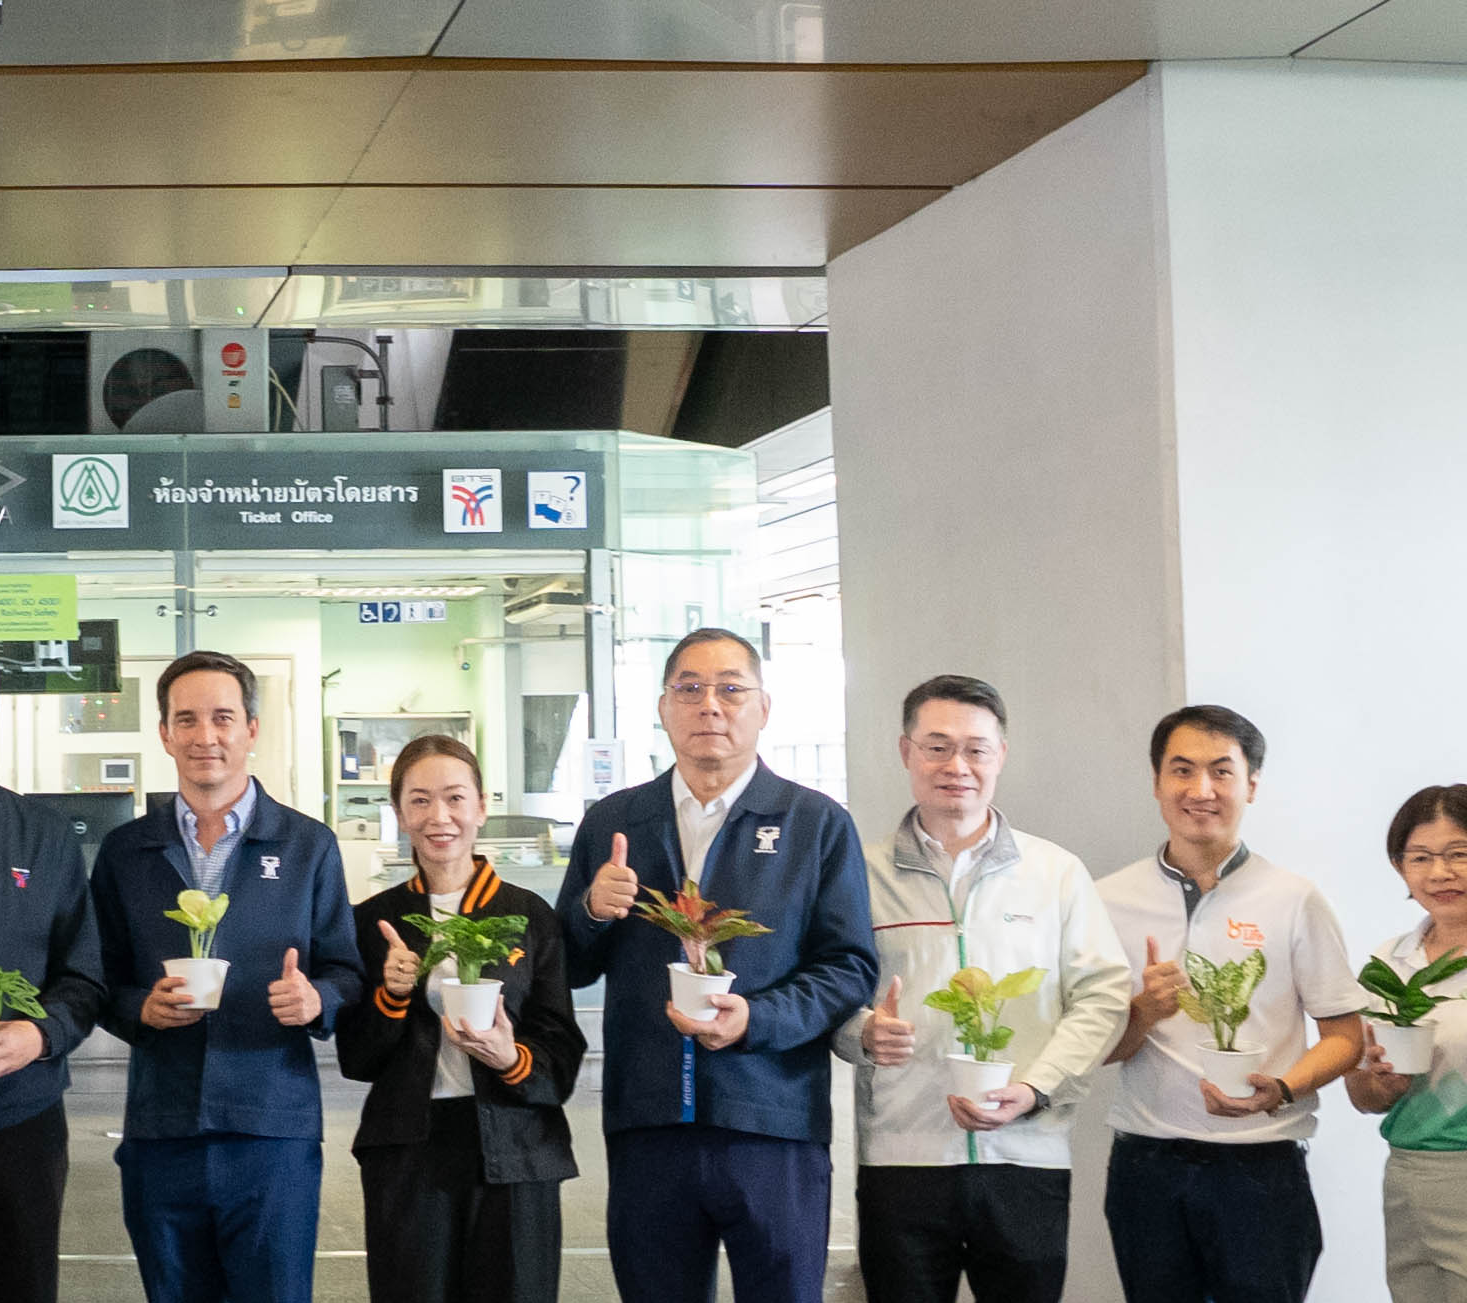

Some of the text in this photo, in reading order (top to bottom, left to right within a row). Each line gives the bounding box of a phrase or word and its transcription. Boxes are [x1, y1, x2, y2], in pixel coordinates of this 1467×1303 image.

[152, 475, 420, 505] ห้องจำหน่ายบัตรโดยสาร
[239, 510, 334, 524] Ticket Office
